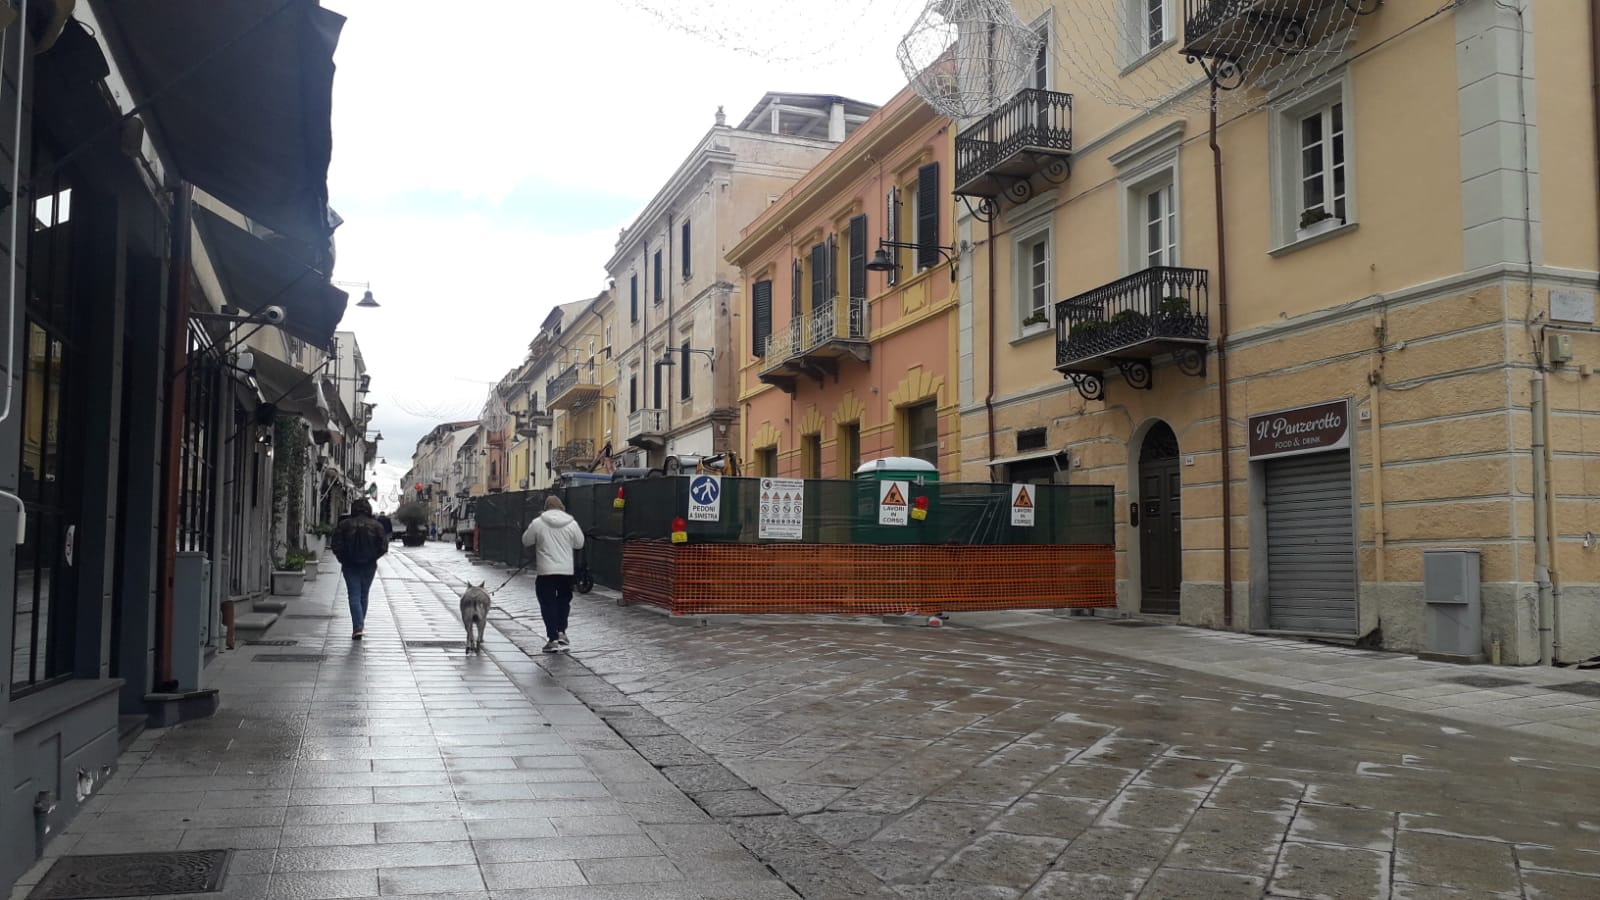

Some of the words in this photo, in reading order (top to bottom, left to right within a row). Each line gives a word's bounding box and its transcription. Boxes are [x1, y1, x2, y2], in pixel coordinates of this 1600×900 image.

[1256, 419, 1270, 440] Il
[1271, 412, 1341, 438] Panzerotto
[1275, 440, 1292, 449] FOOD
[1293, 437, 1300, 446] &
[1302, 436, 1321, 445] DRINK
[692, 505, 716, 513] PEDONI
[694, 512, 718, 520] SINISTRA
